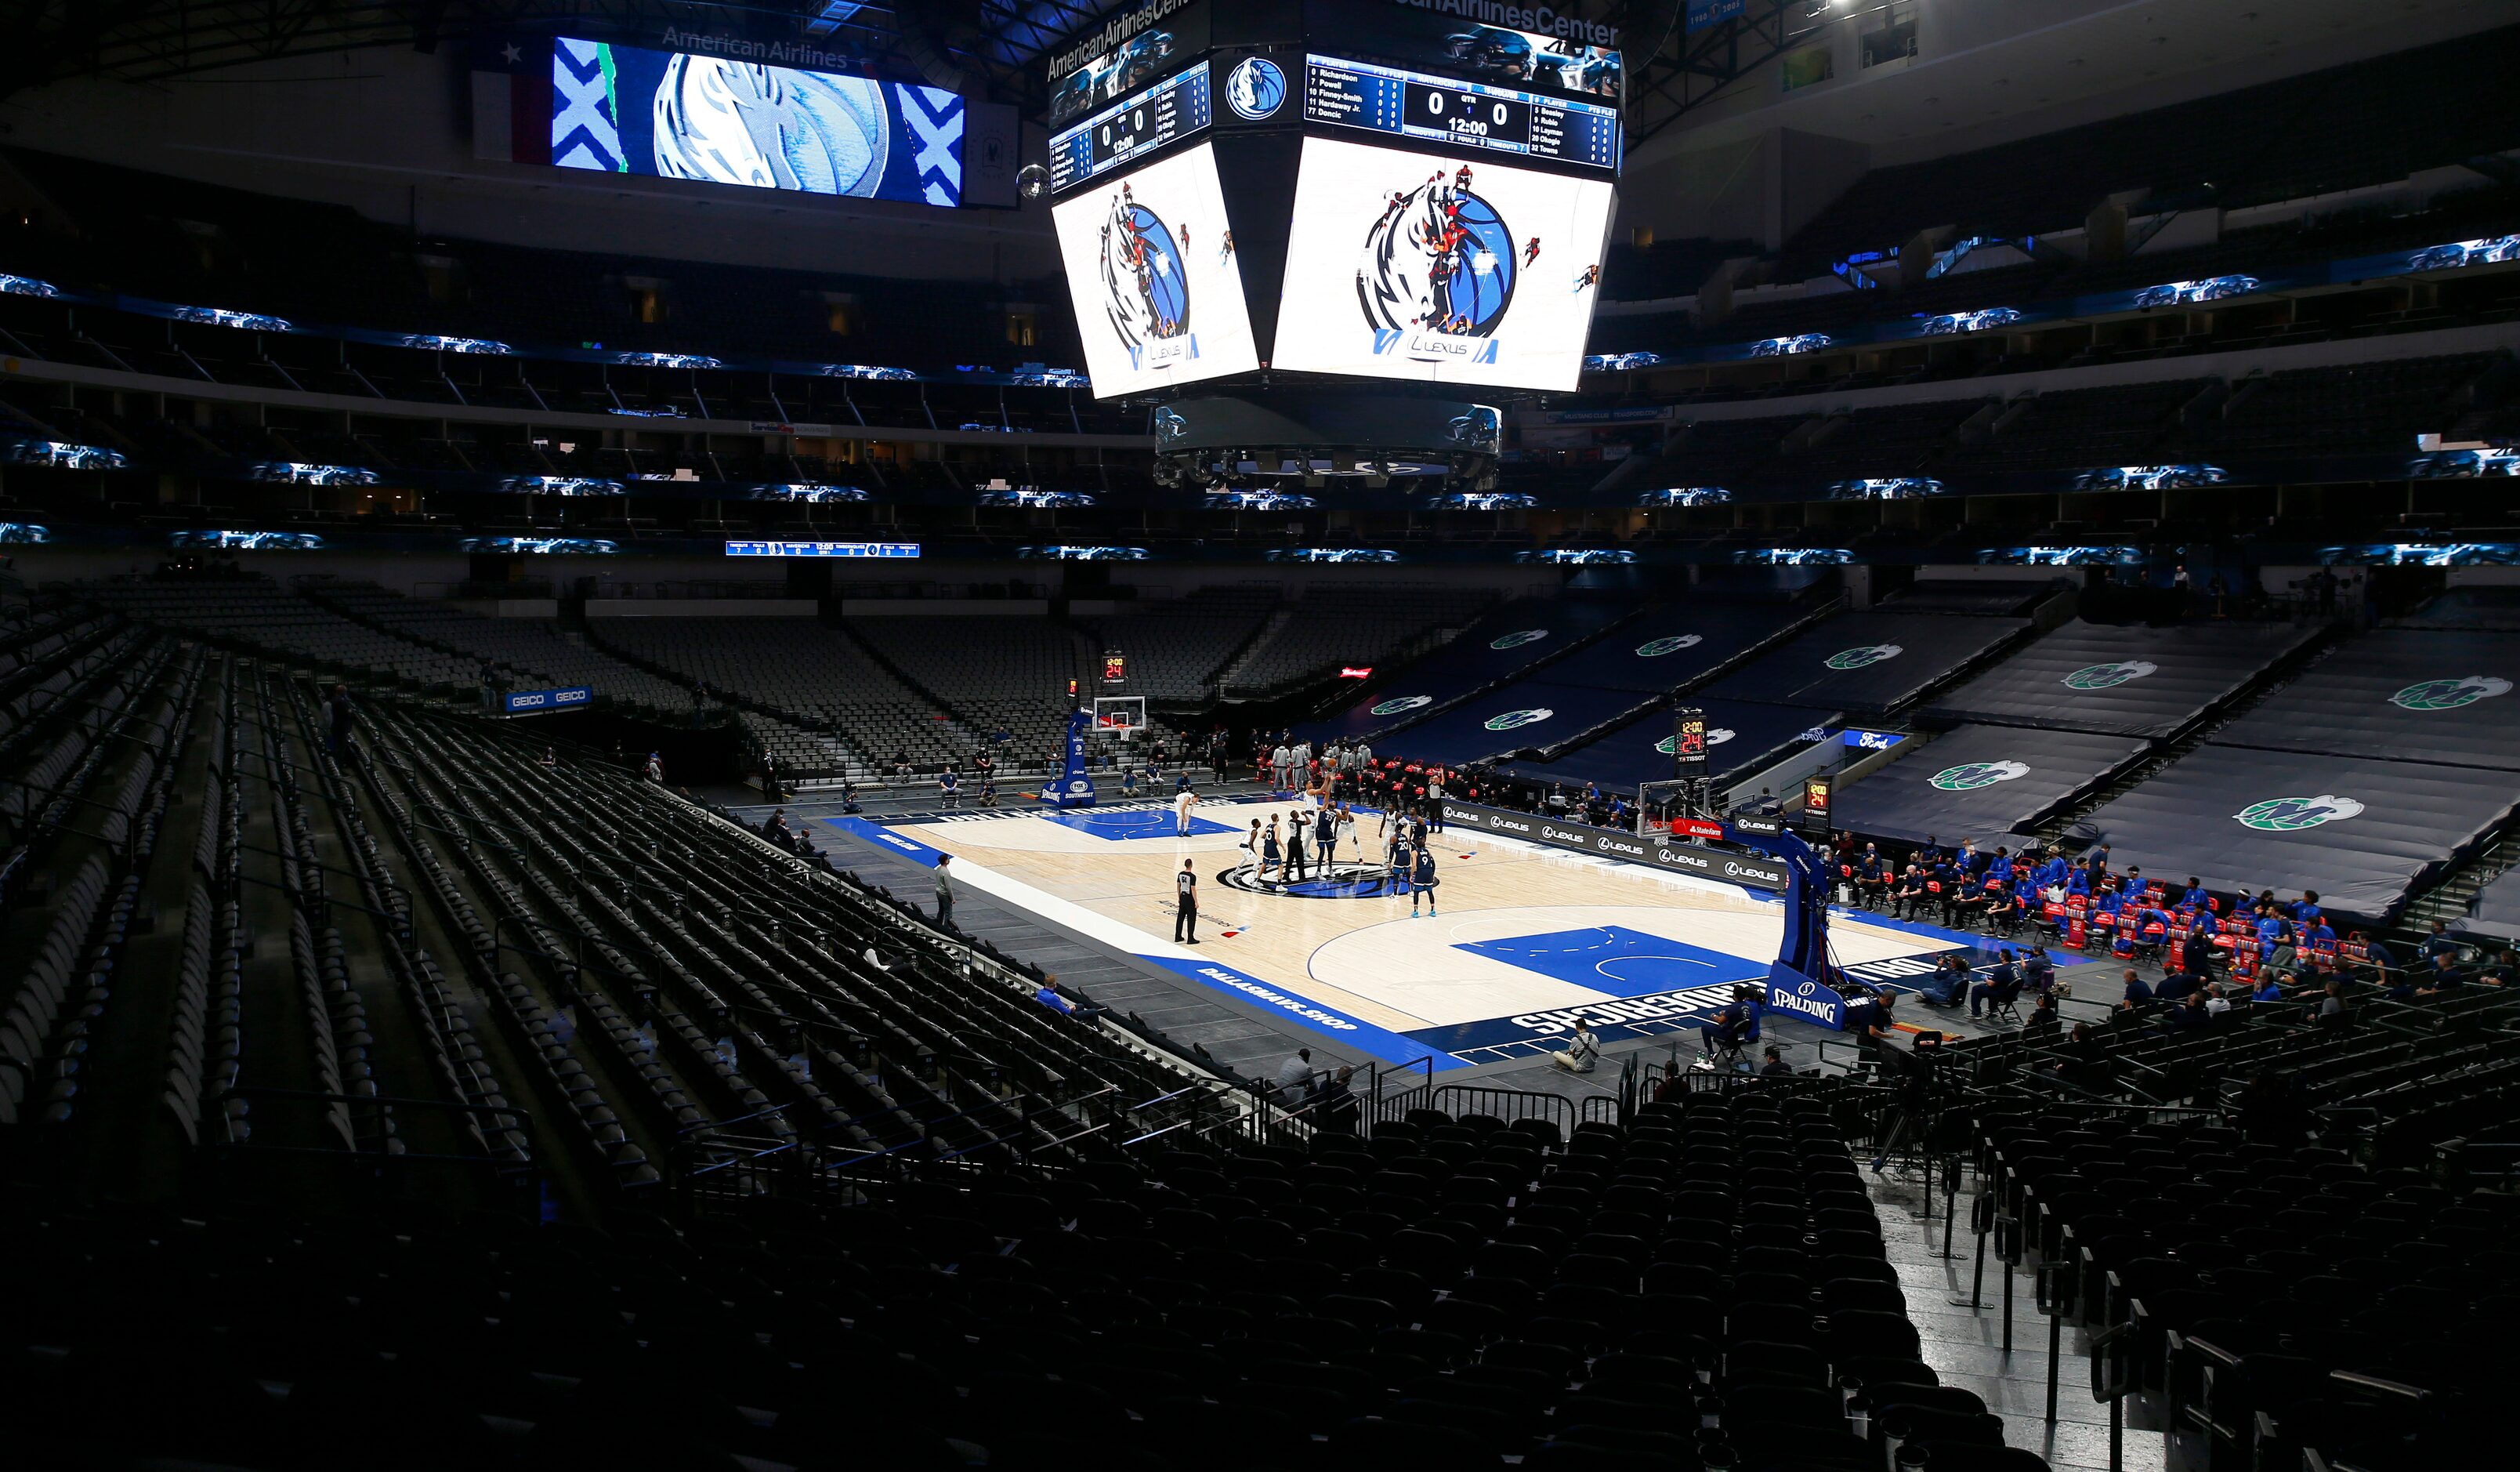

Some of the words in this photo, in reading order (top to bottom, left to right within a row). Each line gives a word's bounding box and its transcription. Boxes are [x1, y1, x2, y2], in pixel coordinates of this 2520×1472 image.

[661, 25, 766, 58] American
[768, 41, 848, 69] Airlines
[1320, 69, 1358, 82] Richardson
[1320, 79, 1341, 89] Powell
[1417, 75, 1457, 89] MAVERICKS
[1319, 89, 1362, 103] Finney-Smith
[1318, 99, 1352, 113] Hardaway
[1428, 92, 1443, 114] 0
[1461, 96, 1476, 104] QTR
[1494, 103, 1508, 125] 0
[1544, 98, 1567, 108] PLAYER
[1318, 108, 1341, 119] Doncic
[1541, 108, 1564, 119] Beasley
[1102, 125, 1111, 147] 0
[1135, 110, 1143, 132] 0
[1449, 118, 1487, 136] 12:00
[1541, 118, 1558, 127] Rubio
[1406, 128, 1435, 138] TIMEOUTS
[1541, 126, 1563, 137] Layman
[1113, 135, 1134, 154] 12:00
[1457, 135, 1476, 144] FOULS
[1489, 140, 1517, 151] TIMEOUTS
[1540, 135, 1561, 146] Okogie
[1539, 144, 1558, 155] Towns
[1158, 346, 1181, 359] LEXUS
[1425, 342, 1467, 354] LEXUS
[1106, 666, 1121, 677] 24
[512, 694, 544, 707] GEICO
[556, 690, 585, 702] GEICO
[1682, 721, 1702, 733] 12:00
[1682, 734, 1701, 752] 24
[1859, 732, 1888, 749] Ford
[1810, 784, 1827, 795] 12:00
[1041, 789, 1061, 803] SPALDING
[1810, 795, 1823, 806] 24
[1453, 811, 1479, 821] LEXUS
[1501, 821, 1530, 832] LEXUS
[1747, 821, 1776, 831] LEXUS
[1553, 831, 1584, 843] LEXUS
[1398, 842, 1409, 851] 20
[1609, 842, 1644, 855] LEXUS
[1421, 856, 1428, 865] 9
[1671, 854, 1708, 868] LEXUS
[1738, 868, 1779, 882] LEXUS
[1196, 967, 1358, 1031] DALLASMAVS.SHOP
[1772, 988, 1837, 1024] SPALDING
